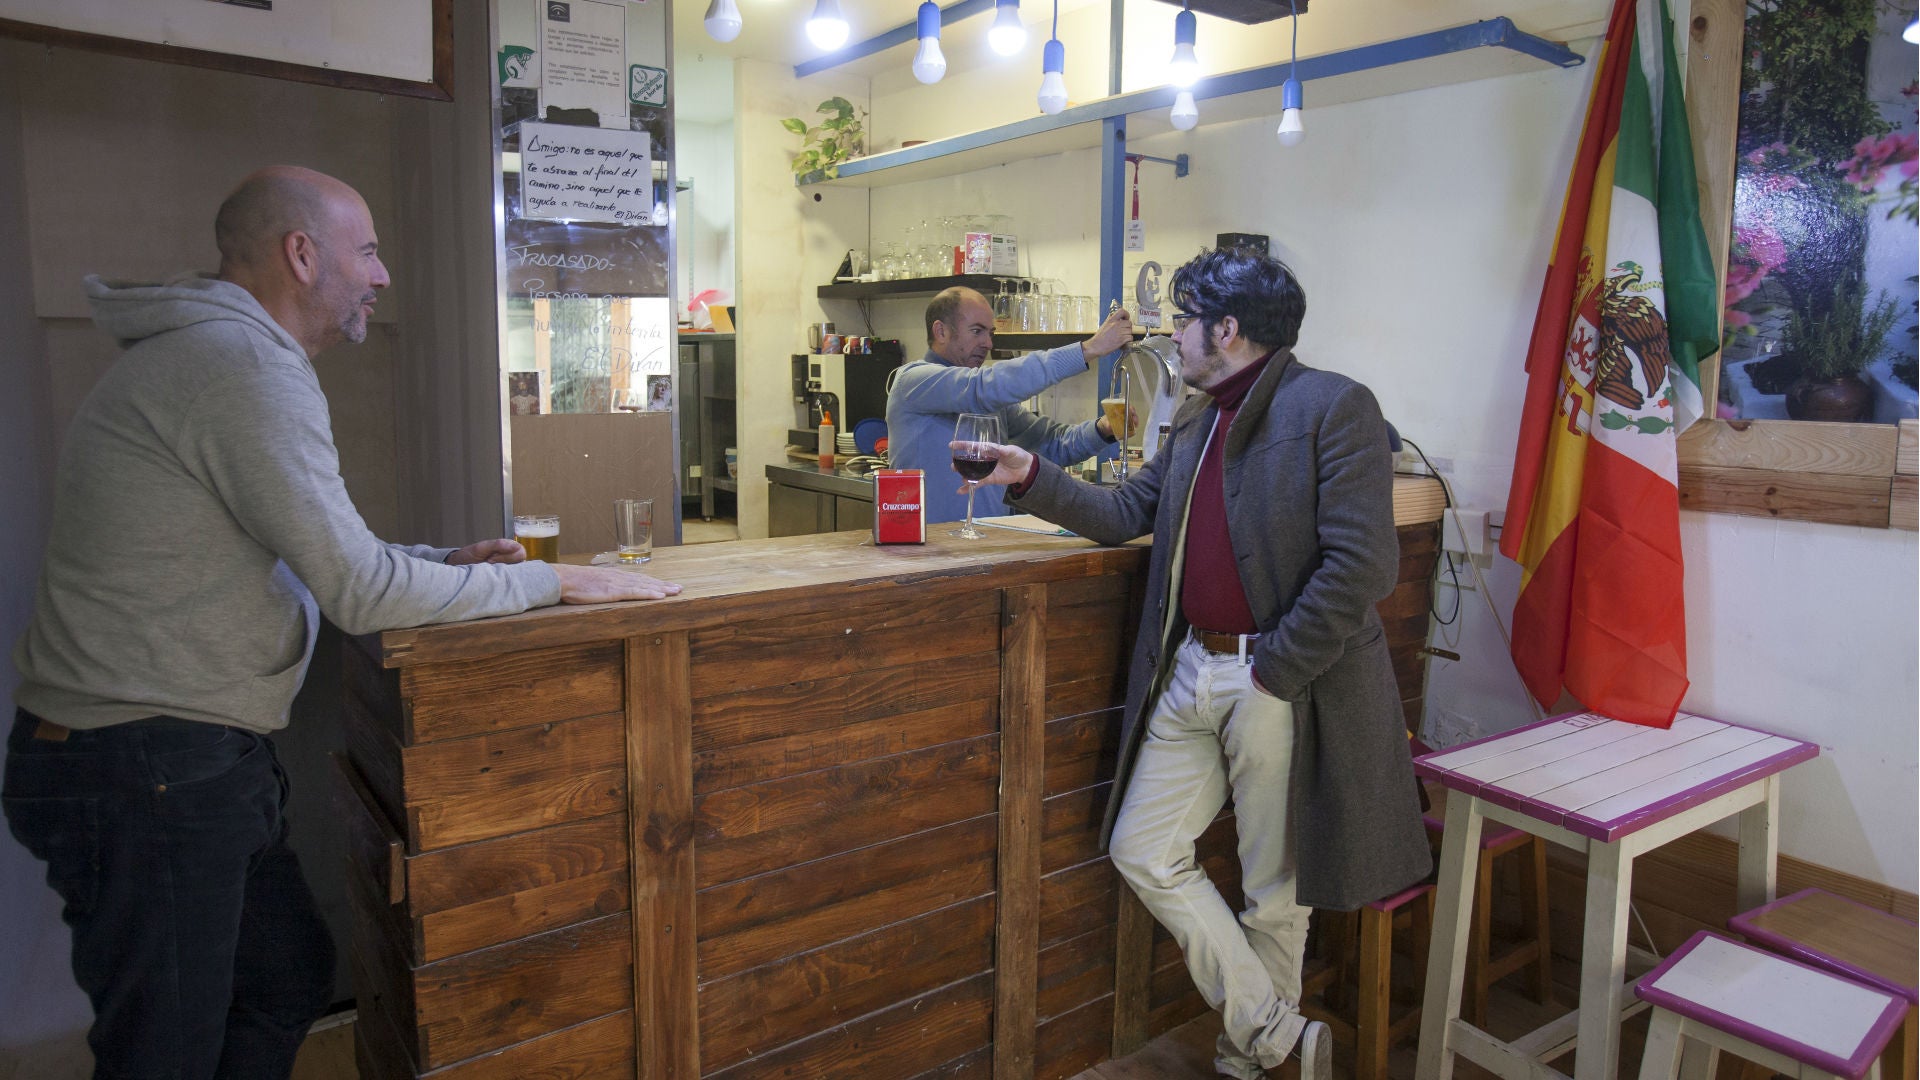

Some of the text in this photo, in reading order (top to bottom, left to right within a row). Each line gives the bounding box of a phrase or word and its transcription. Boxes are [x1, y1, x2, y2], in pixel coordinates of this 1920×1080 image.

[597, 148, 629, 161] aquel
[527, 162, 638, 181] te abraza al final del
[589, 185, 615, 197] aquel
[522, 278, 632, 314] Persona que
[882, 503, 920, 511] Cruzcampo
